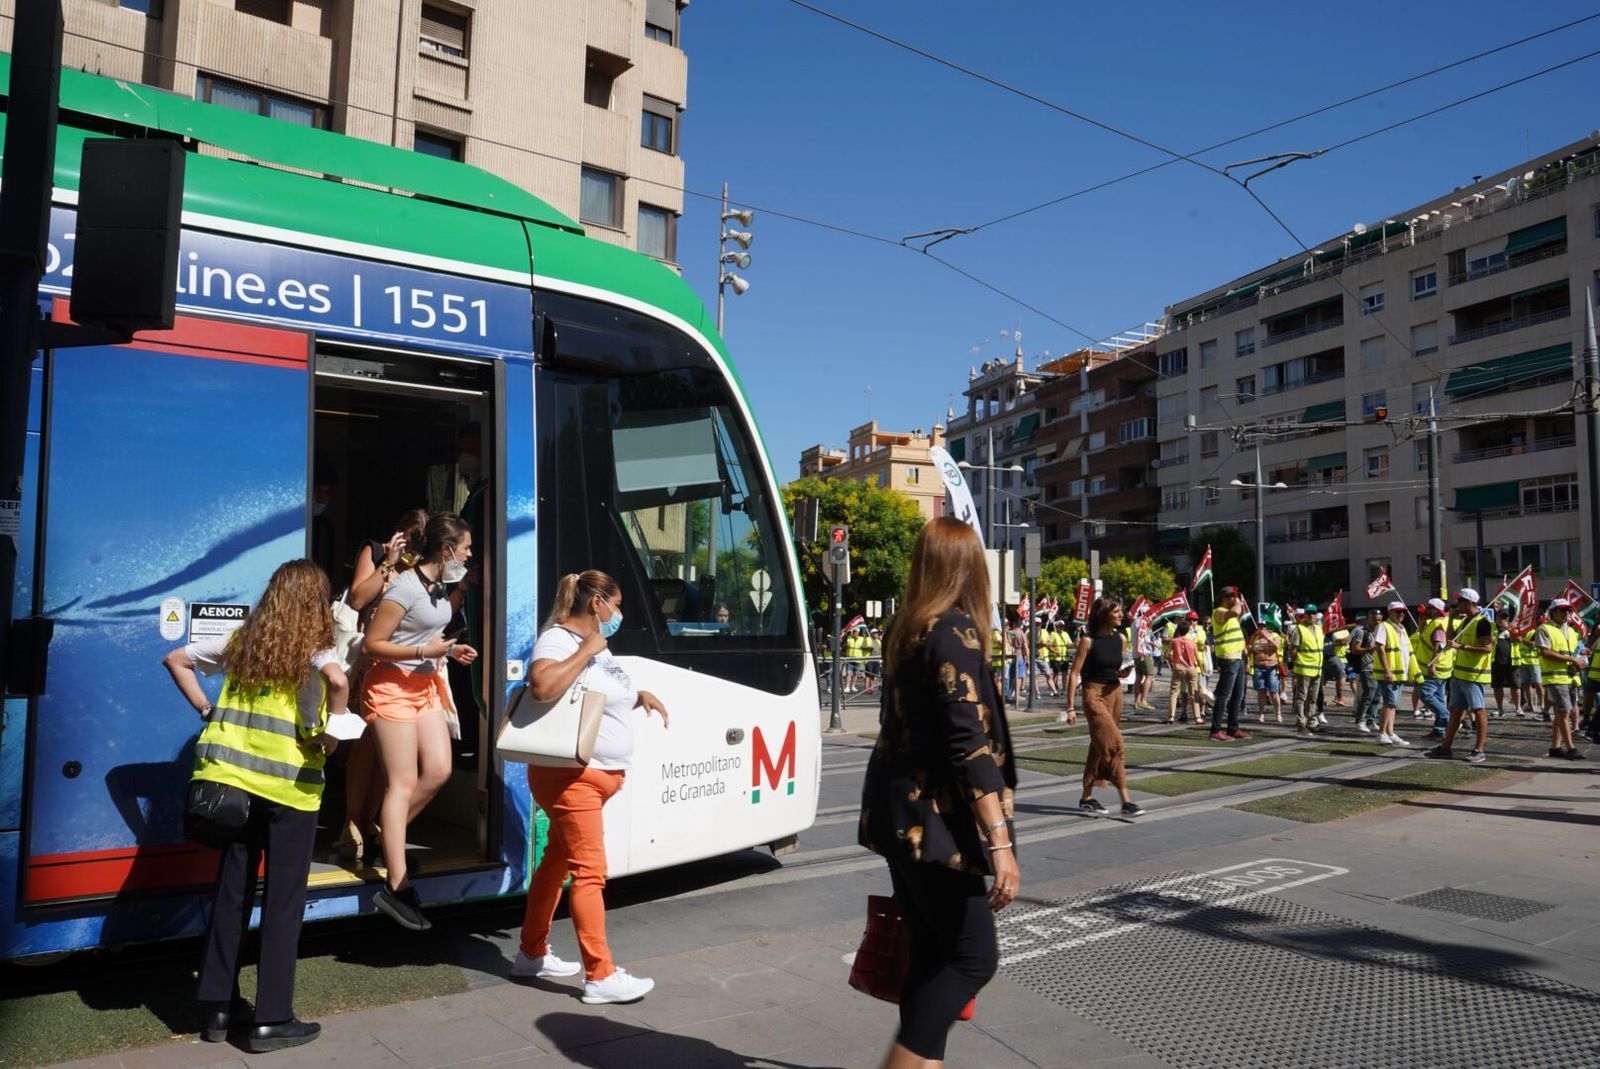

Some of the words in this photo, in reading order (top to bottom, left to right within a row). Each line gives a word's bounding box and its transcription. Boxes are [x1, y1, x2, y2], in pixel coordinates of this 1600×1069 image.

[385, 286, 488, 336] 1551
[198, 606, 244, 618] AENOR
[1076, 585, 1090, 619] CCOO
[661, 755, 741, 780] Metropolitano
[752, 720, 796, 804] M
[661, 786, 676, 804] de
[679, 779, 725, 800] Granada
